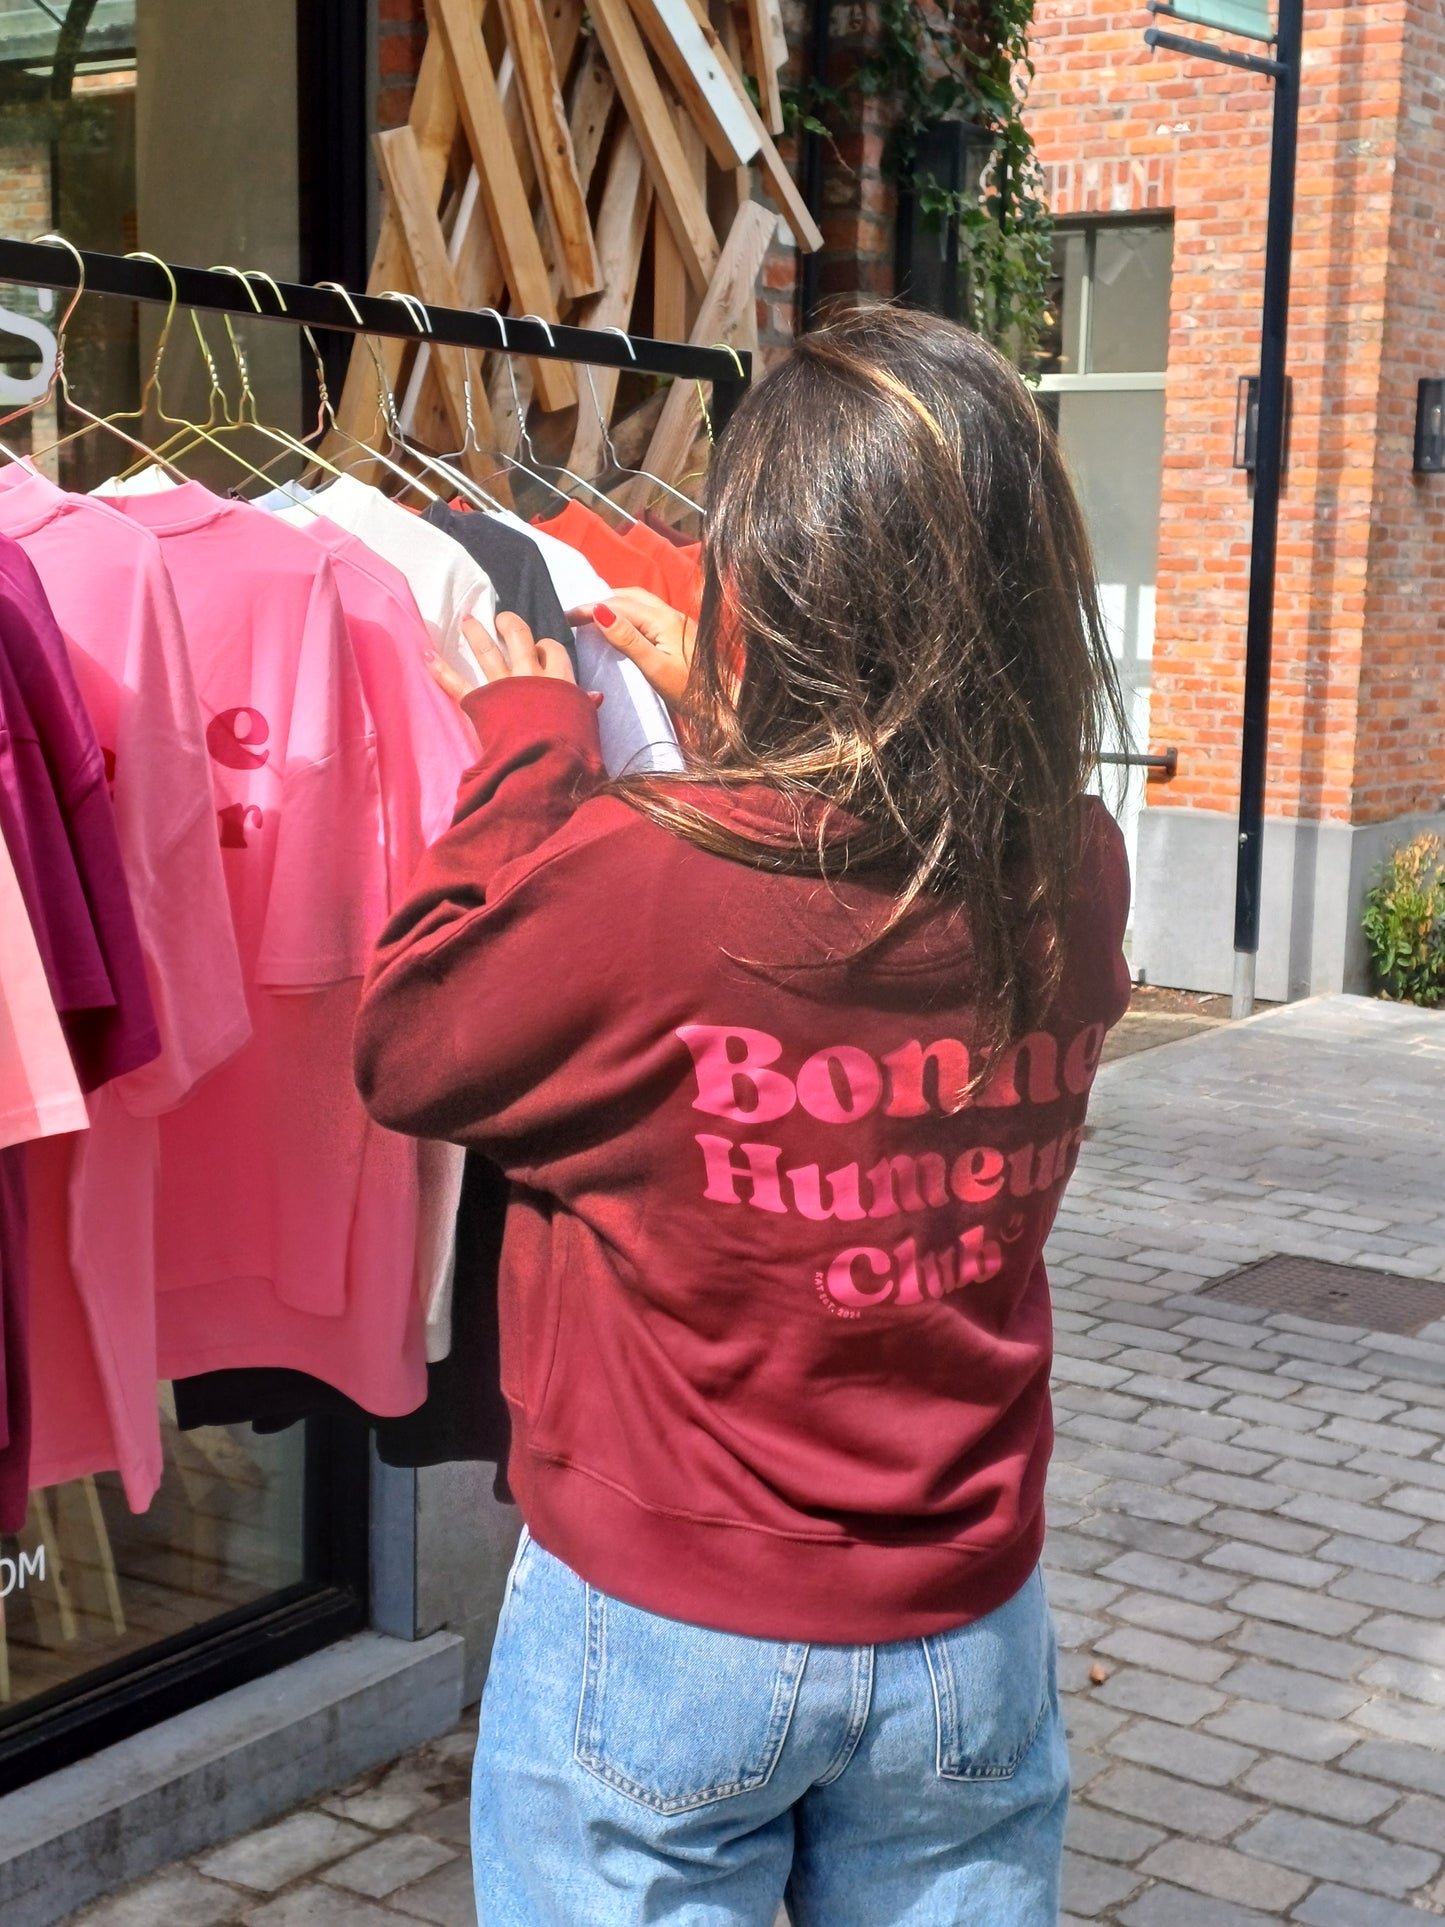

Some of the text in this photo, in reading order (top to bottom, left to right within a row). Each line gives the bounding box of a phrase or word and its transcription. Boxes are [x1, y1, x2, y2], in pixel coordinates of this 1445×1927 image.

[675, 1021, 1105, 1124] Bonne
[694, 1124, 1084, 1221] Humeur
[827, 1224, 1003, 1307] Club
